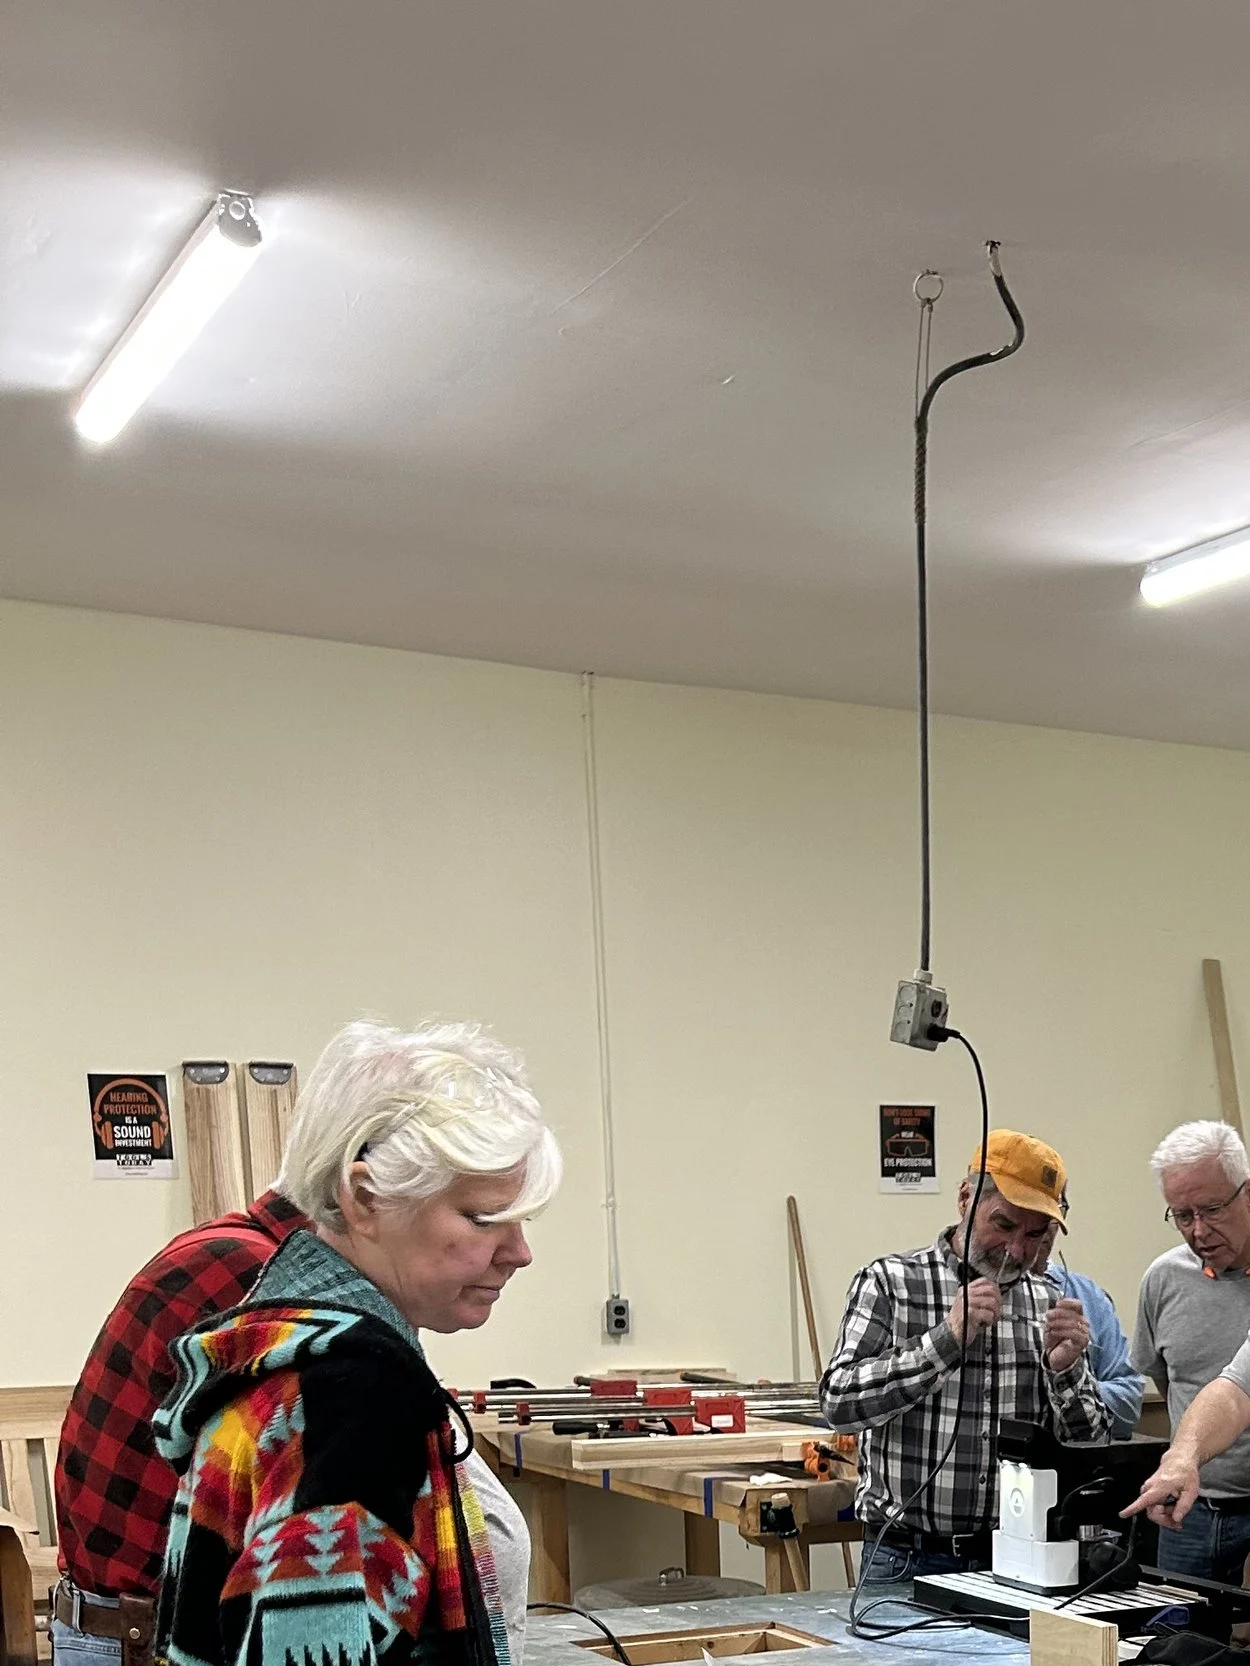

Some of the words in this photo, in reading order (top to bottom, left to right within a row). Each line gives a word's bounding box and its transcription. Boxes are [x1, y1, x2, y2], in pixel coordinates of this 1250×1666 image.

[110, 1092, 148, 1102] HEARING
[103, 1104, 157, 1115] PROTECTION
[125, 1116, 132, 1124] IS
[133, 1116, 138, 1124] A
[113, 1126, 151, 1138] SOUND
[115, 1139, 152, 1147] INVESTMENT
